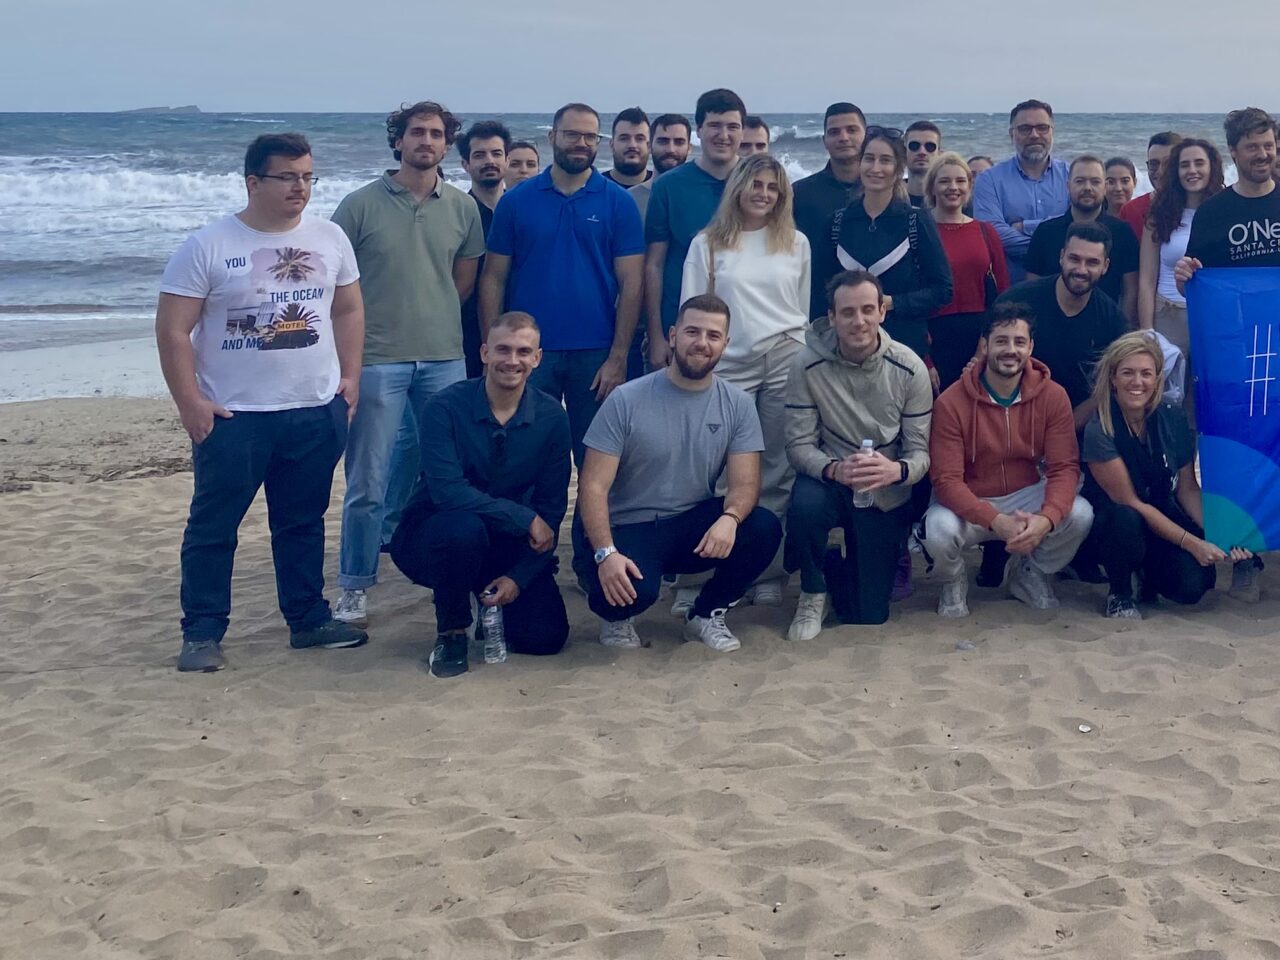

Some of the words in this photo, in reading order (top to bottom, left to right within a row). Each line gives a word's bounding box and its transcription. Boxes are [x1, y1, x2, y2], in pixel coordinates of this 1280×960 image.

[909, 213, 918, 249] GUESS
[1230, 241, 1265, 255] SANTA
[1231, 248, 1275, 261] CALIFORNIA
[225, 256, 246, 269] YOU
[270, 291, 290, 303] THE
[292, 288, 324, 301] OCEAN
[222, 339, 243, 350] AND
